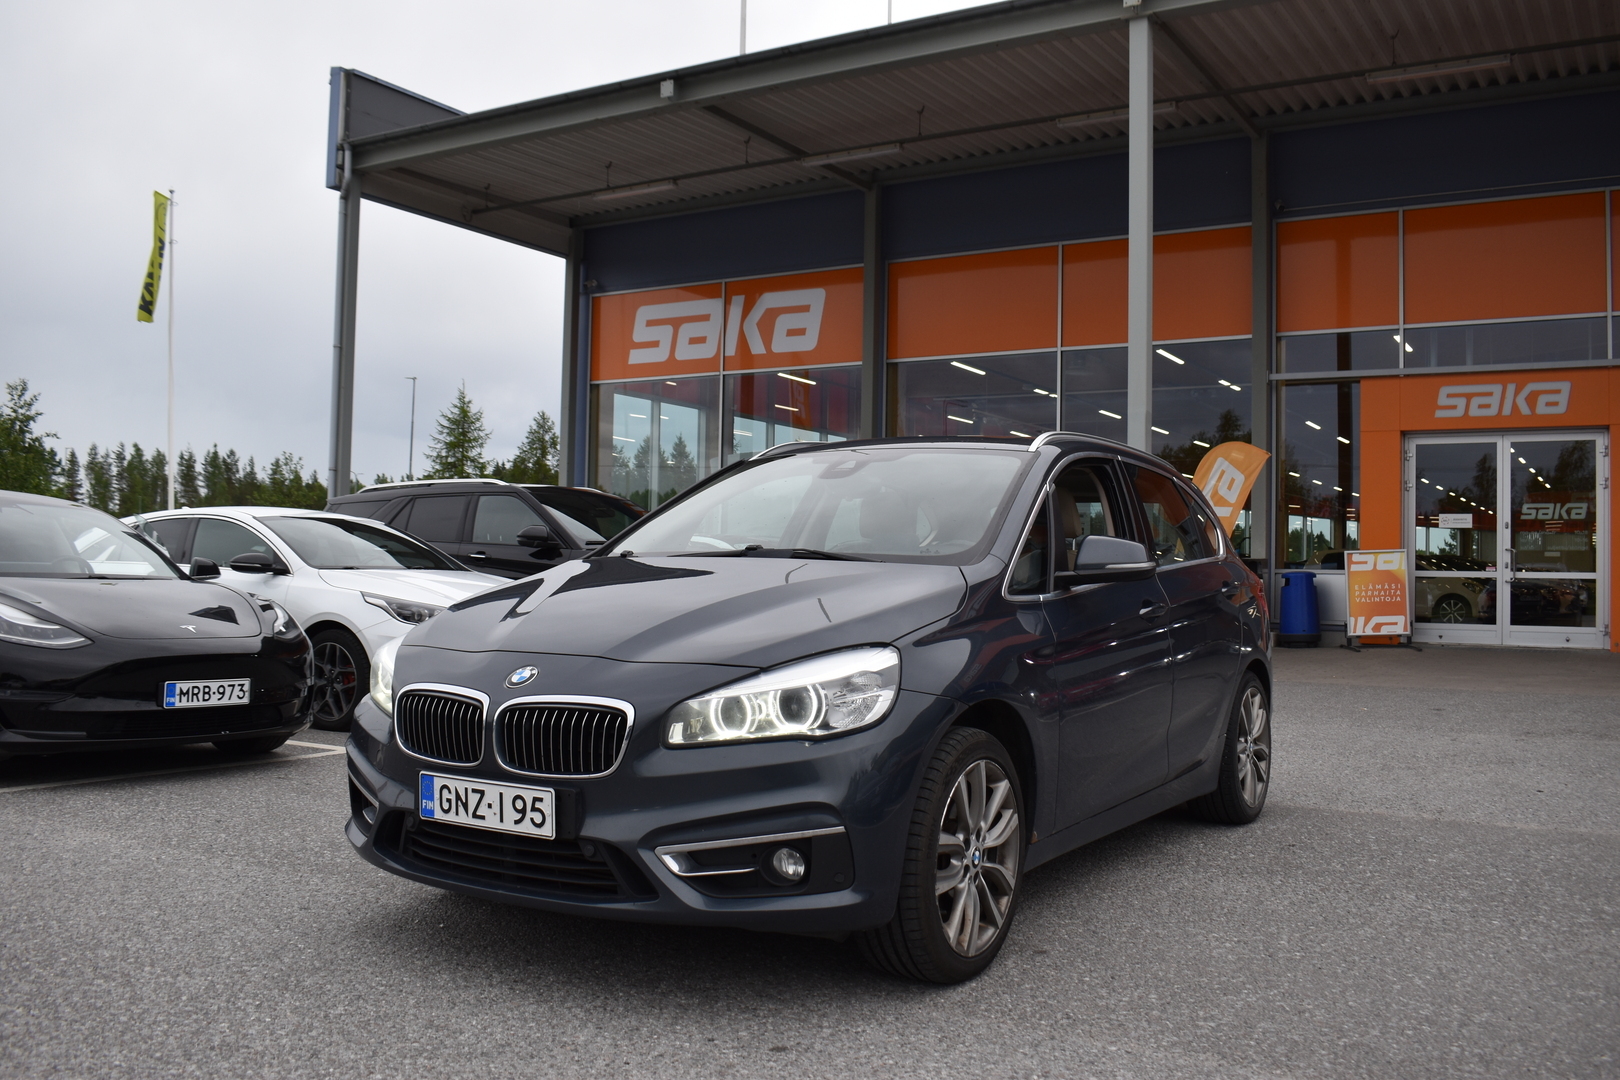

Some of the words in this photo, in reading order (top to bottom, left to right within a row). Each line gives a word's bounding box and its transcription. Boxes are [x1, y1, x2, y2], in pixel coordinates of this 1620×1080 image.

[179, 683, 246, 703] MRB-973
[422, 800, 434, 810] FIN
[439, 784, 546, 829] GNZ-195
